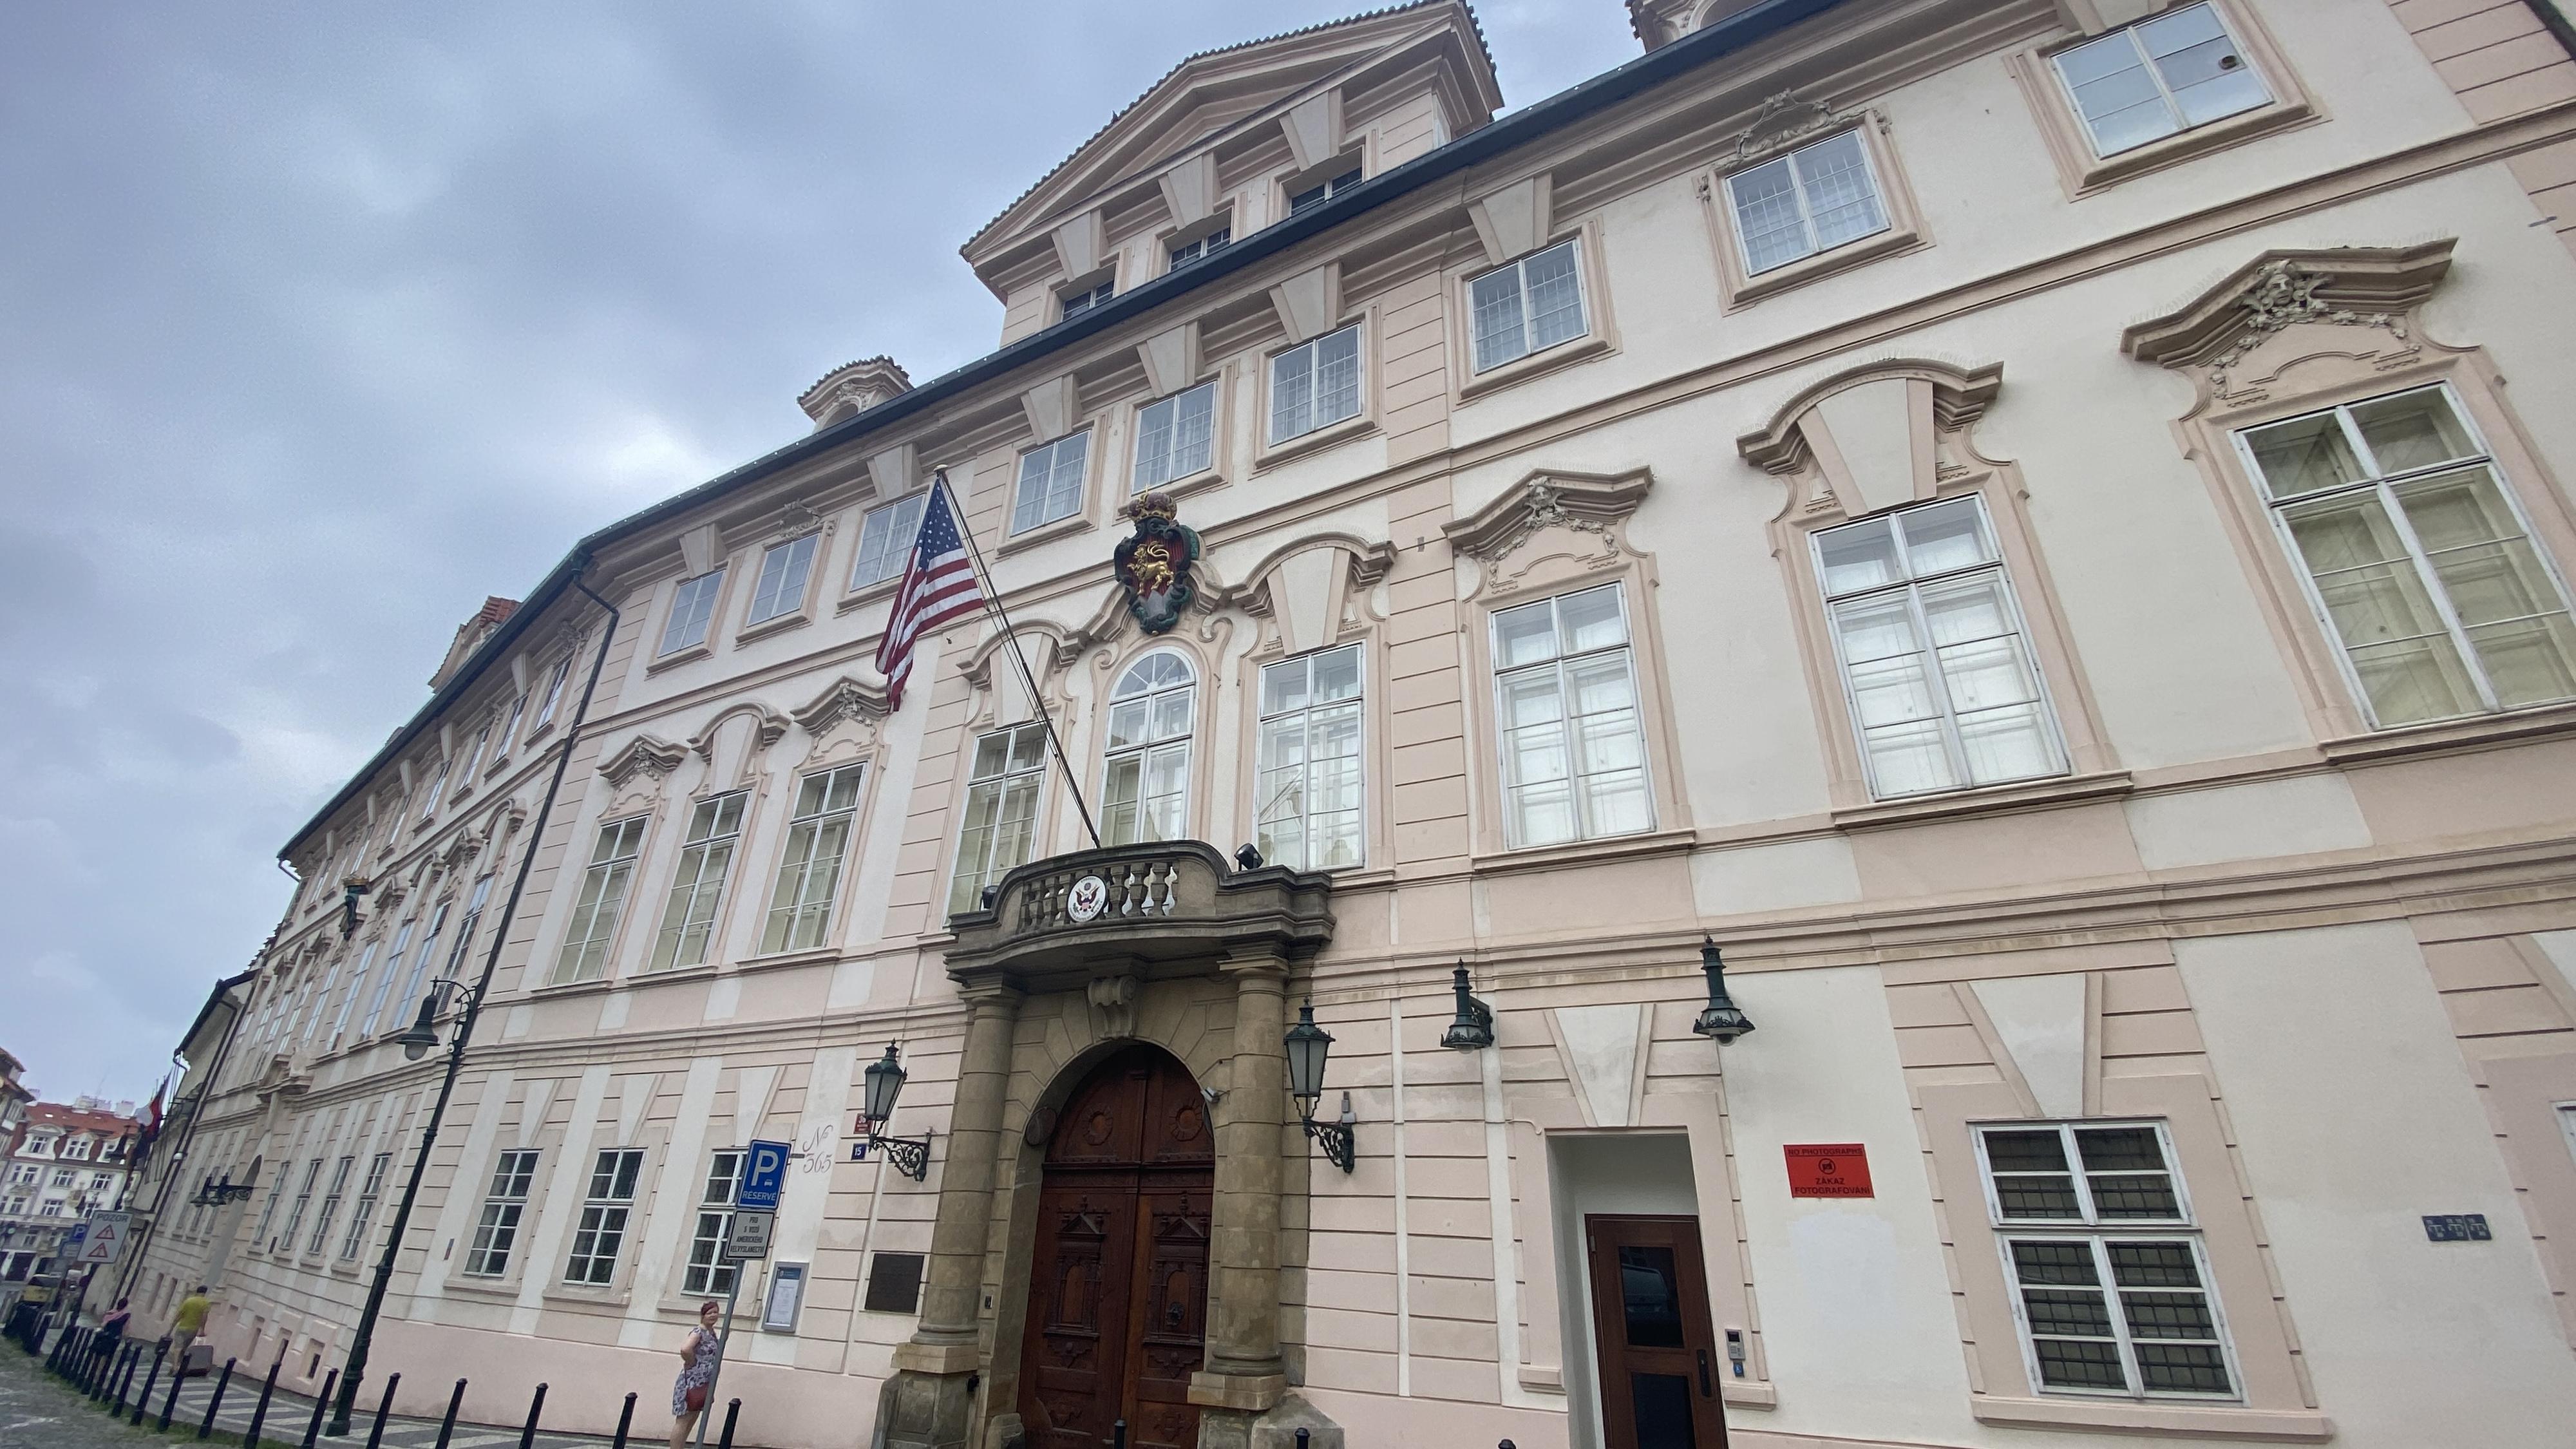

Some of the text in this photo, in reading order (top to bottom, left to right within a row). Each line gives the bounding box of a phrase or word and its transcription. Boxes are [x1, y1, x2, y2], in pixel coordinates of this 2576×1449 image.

[855, 1146, 862, 1156] 15
[750, 1150, 779, 1186] P
[97, 1213, 128, 1222] POZOR
